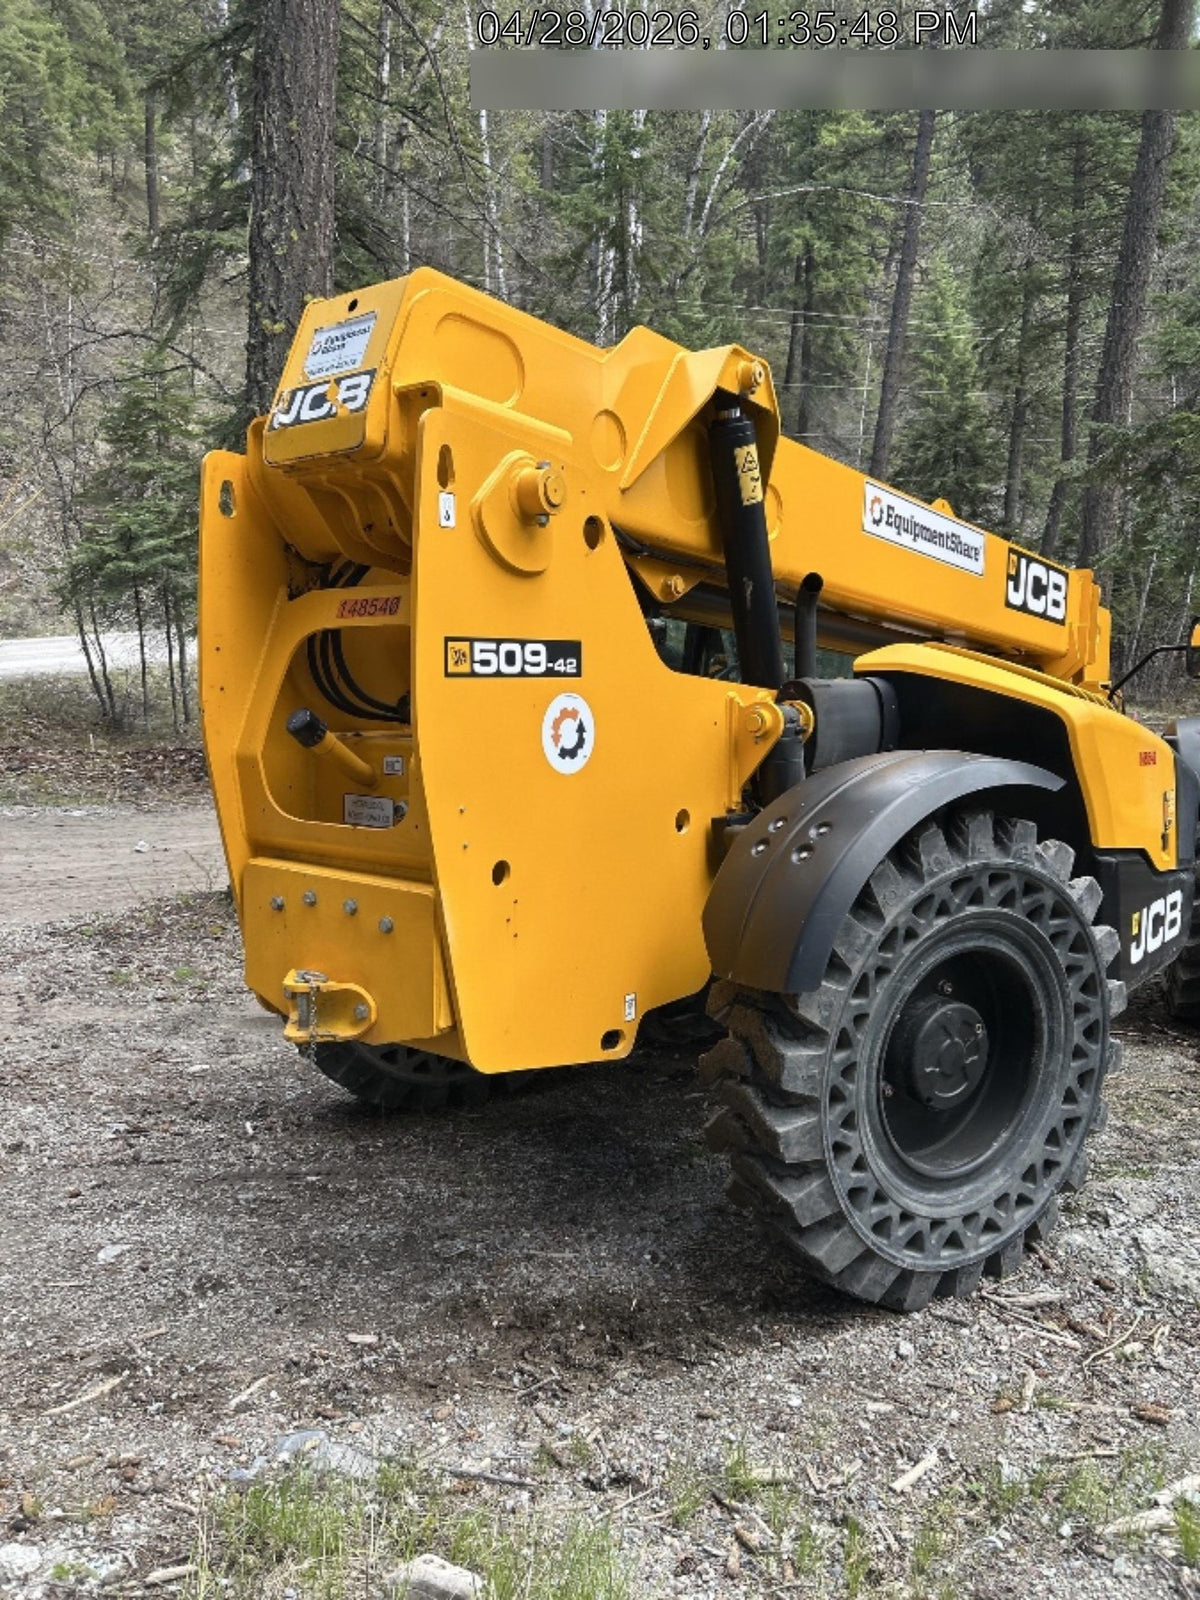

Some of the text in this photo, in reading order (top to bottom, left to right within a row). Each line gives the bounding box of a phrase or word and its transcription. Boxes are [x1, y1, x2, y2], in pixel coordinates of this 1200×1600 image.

[272, 374, 371, 428] JCB
[885, 505, 981, 562] EquipmentShare
[1007, 557, 1067, 620] JCB
[472, 641, 577, 675] 509-42
[1130, 889, 1183, 965] JCB
